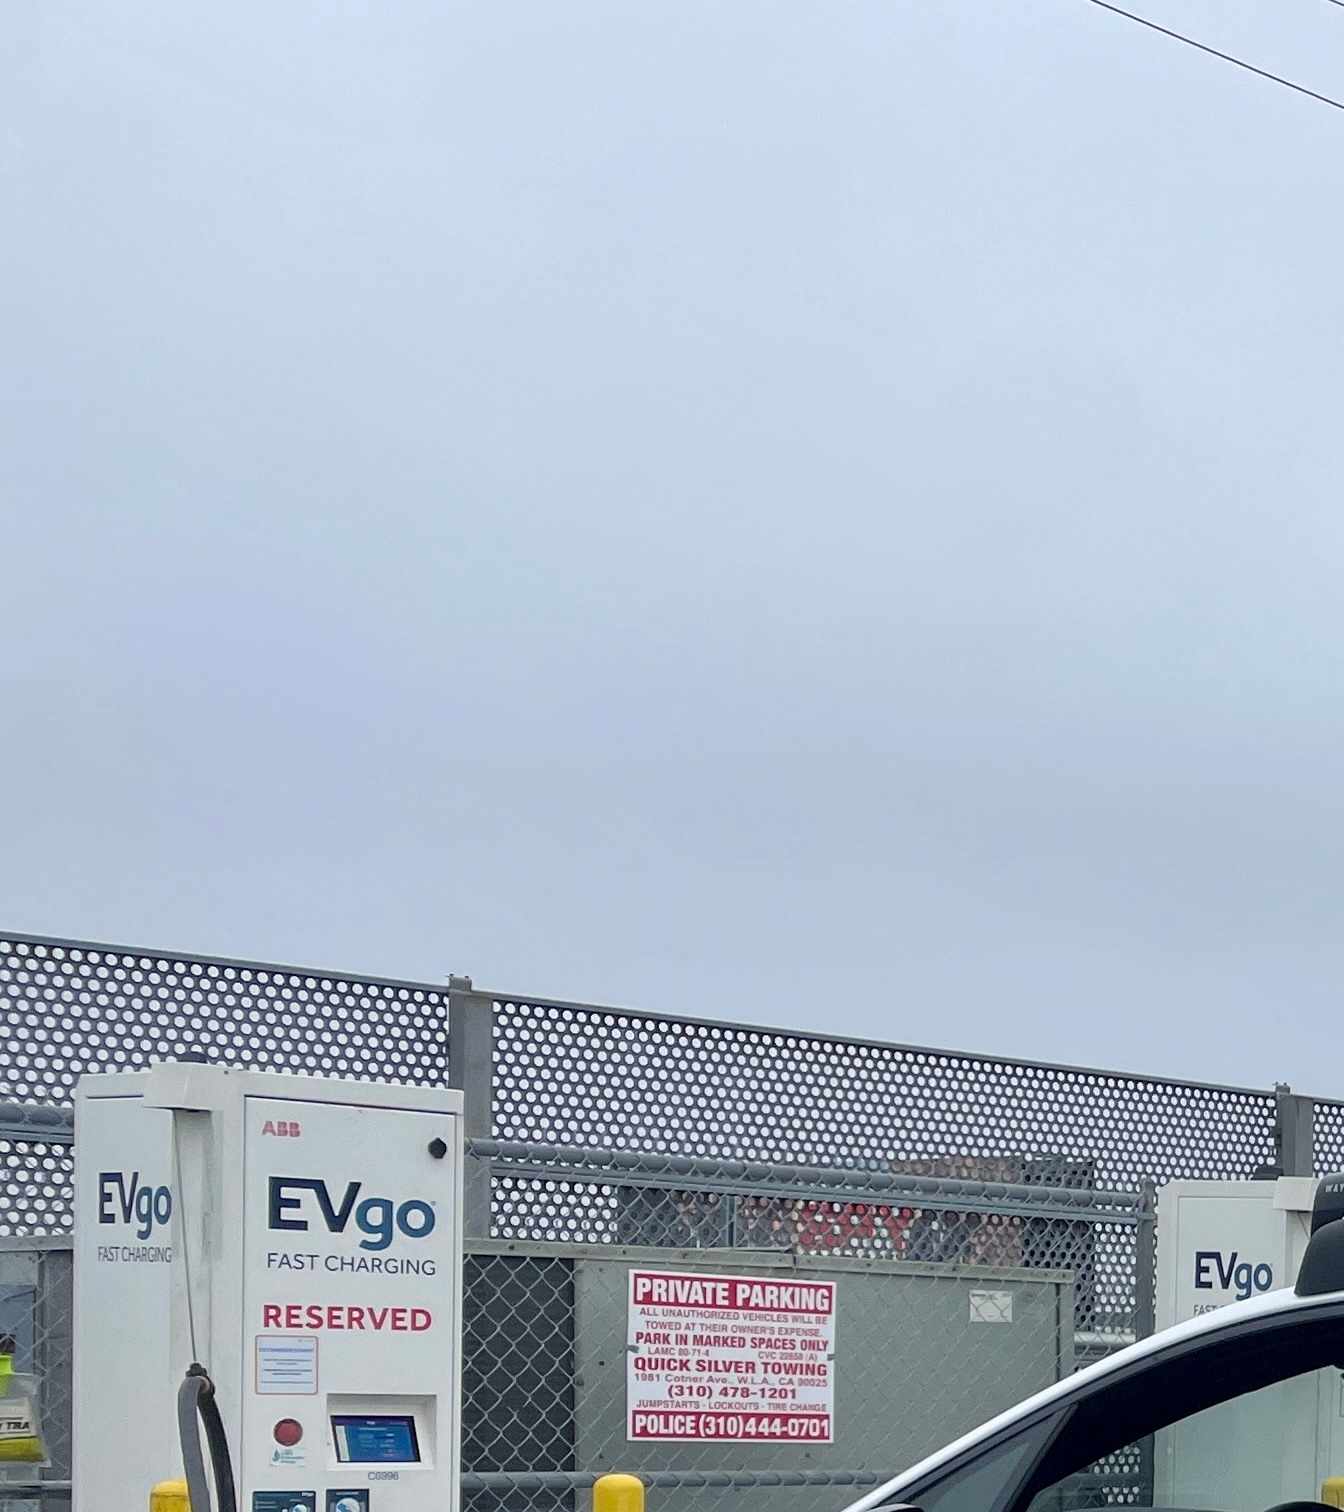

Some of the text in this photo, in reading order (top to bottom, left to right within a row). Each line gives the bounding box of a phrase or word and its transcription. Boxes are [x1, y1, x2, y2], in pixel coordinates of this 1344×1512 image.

[262, 1121, 301, 1138] ABB
[98, 1171, 172, 1240] EVgo
[268, 1175, 436, 1251] EVgo
[98, 1246, 173, 1263] FAST CHARGING
[267, 1253, 436, 1276] FAST CHARGING
[1194, 1251, 1273, 1301] EVgo
[636, 1277, 830, 1312] PRIVATE PARKING
[262, 1303, 433, 1332] RESERVED
[640, 1307, 659, 1317] ALL
[662, 1308, 740, 1321] UNAUTHORIZED
[743, 1313, 789, 1324] VEHICLES
[791, 1315, 814, 1325] WILL
[645, 1320, 682, 1331] TOWED
[684, 1322, 696, 1331] AT
[698, 1323, 728, 1333] THEIR
[731, 1325, 775, 1336] OWNER'S
[636, 1332, 829, 1352] PARK IN MARKED SPACES ONLY
[648, 1347, 675, 1357] LAMC
[758, 1351, 777, 1360] CVC
[634, 1357, 828, 1377] QUICK SILVER TOWING
[634, 1373, 661, 1382] 1981
[778, 1377, 796, 1386] CA
[667, 1385, 797, 1400] (310) 478-1201
[636, 1399, 827, 1413] JUMPSTARTS LOCKOUTS TIRE CHANGE
[635, 1413, 697, 1435] POLICE
